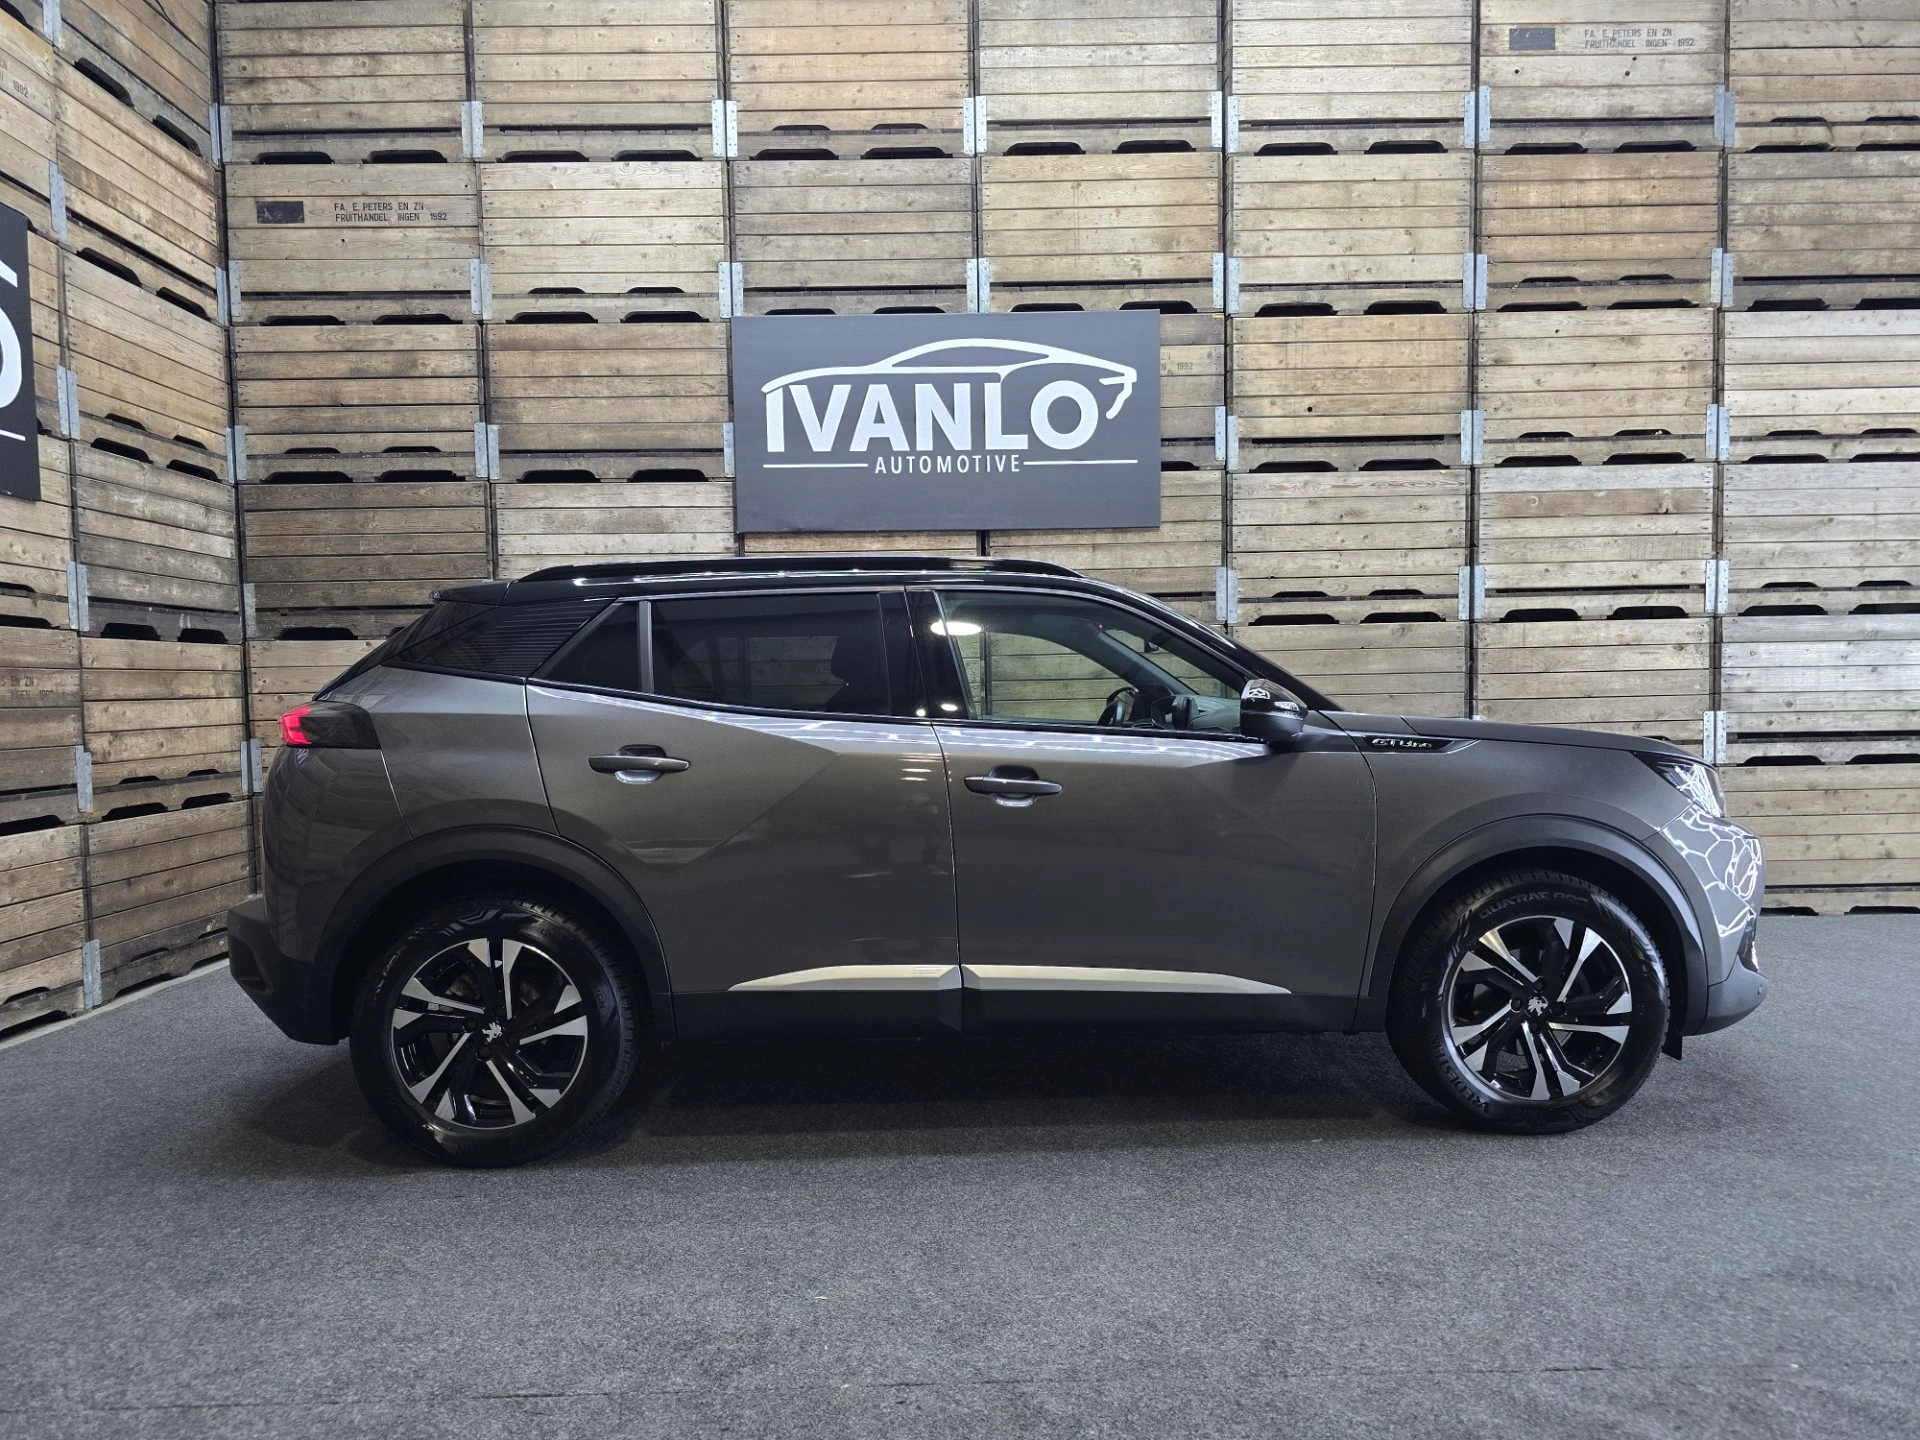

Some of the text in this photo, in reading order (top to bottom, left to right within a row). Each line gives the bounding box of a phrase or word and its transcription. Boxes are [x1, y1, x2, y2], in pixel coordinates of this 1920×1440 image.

[1612, 28, 1642, 38] PETERS
[1646, 28, 1657, 37] EN
[1661, 28, 1672, 37] ZN
[1584, 37, 1695, 49] FRUITHANDEL INGEN 1992
[334, 202, 348, 211] FA.
[362, 202, 393, 211] PETERS
[398, 202, 409, 211] EN
[413, 202, 424, 211] ZN
[335, 212, 448, 222] FRUITHANDEL INGEN 1992
[1176, 361, 1194, 371] 1992
[765, 379, 1099, 453] IVANLO
[874, 454, 1021, 474] AUTOMOTIVE
[1478, 891, 1551, 920] QUATRAC
[1430, 1033, 1491, 1114] VREDESTEIN
